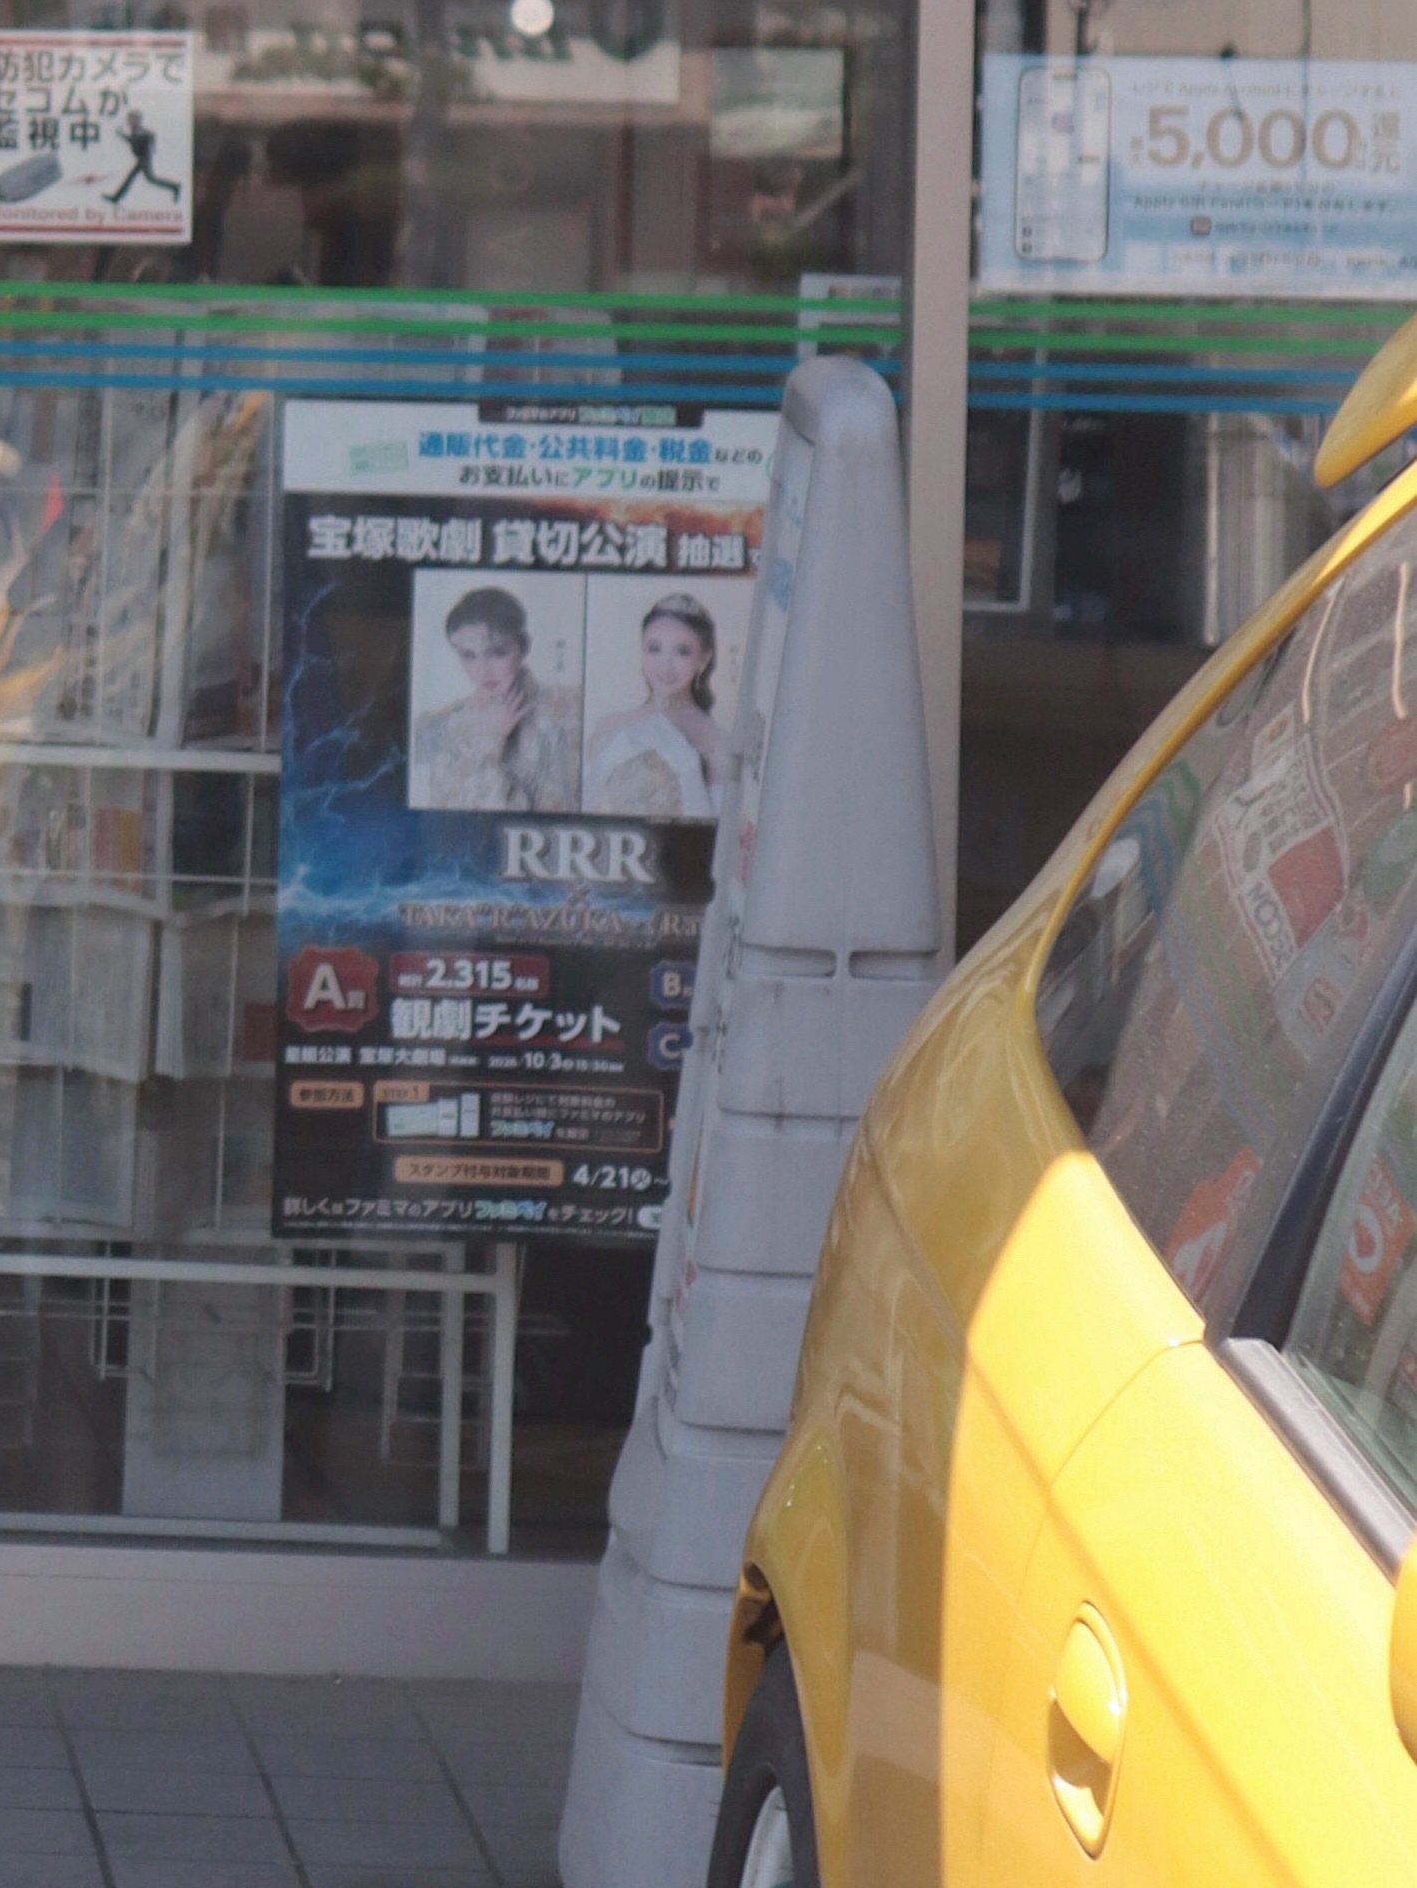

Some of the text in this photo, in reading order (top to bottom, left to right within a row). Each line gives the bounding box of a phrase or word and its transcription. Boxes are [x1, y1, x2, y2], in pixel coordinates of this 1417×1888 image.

[1147, 103, 1360, 171] 5,000
[84, 205, 107, 227] by
[112, 206, 183, 224] Camera
[459, 467, 721, 494] お支払いにアプリの提示で
[306, 515, 480, 563] 宝塚歌劇
[494, 517, 667, 568] 貸切公演
[500, 825, 657, 885] RRR
[389, 996, 623, 1044] 観劇チケット
